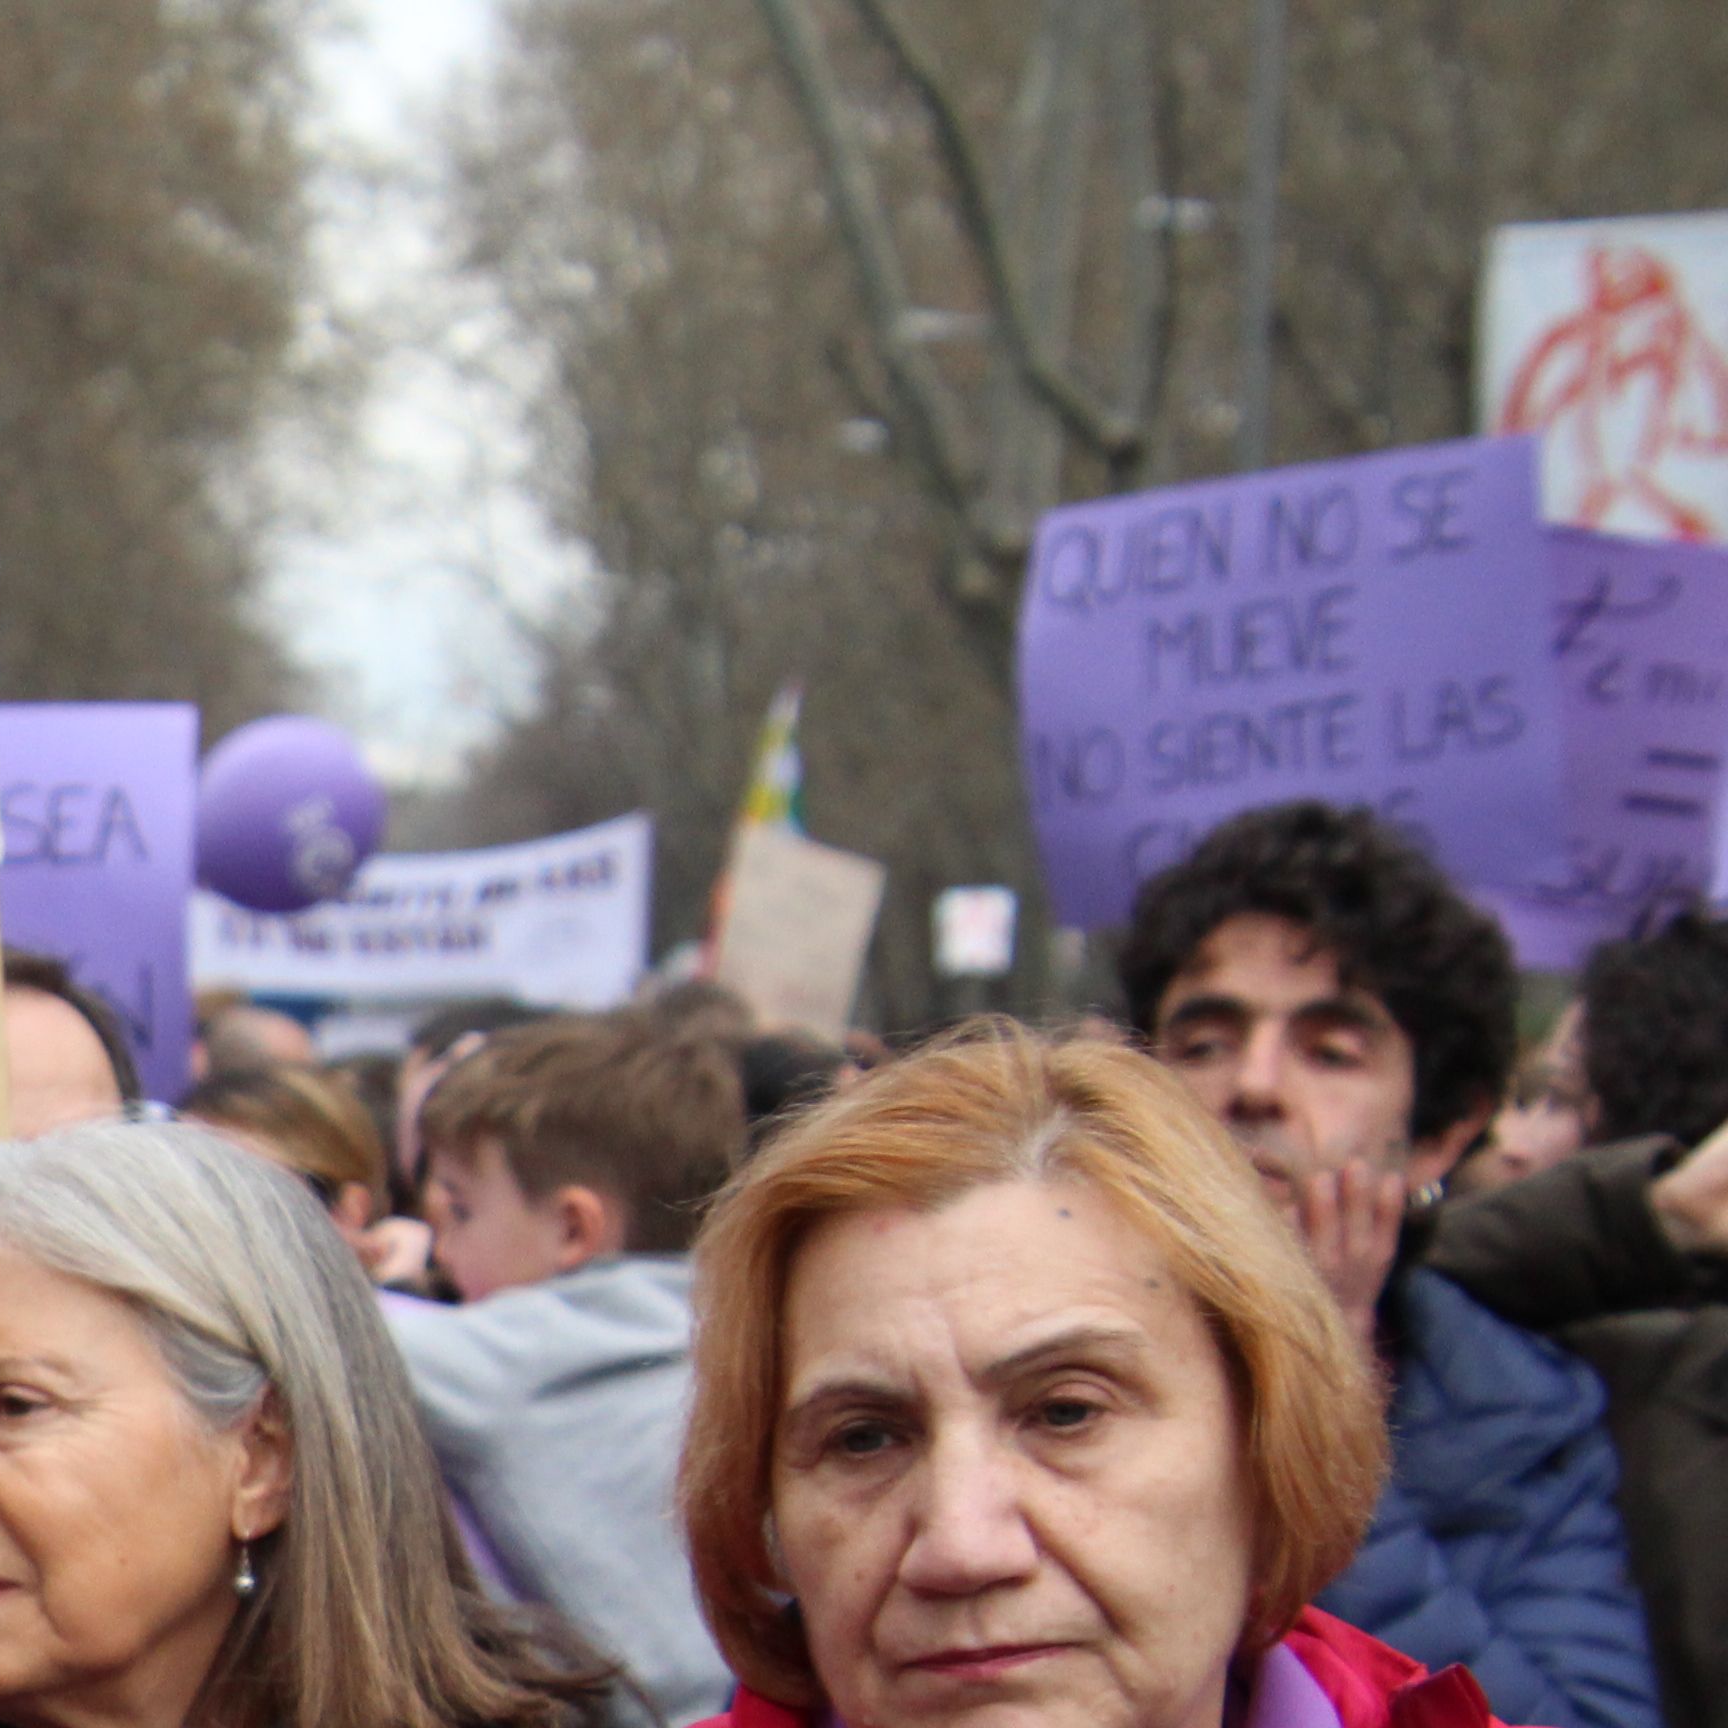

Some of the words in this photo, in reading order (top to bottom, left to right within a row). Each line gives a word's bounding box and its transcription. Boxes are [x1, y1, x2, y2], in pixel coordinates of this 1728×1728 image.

[1261, 484, 1360, 577] NO
[1386, 468, 1478, 562] SE
[1144, 585, 1358, 694] MUEVE
[1033, 724, 1126, 808] NO
[1145, 692, 1362, 794] SIENTE
[1390, 673, 1528, 763] LAS
